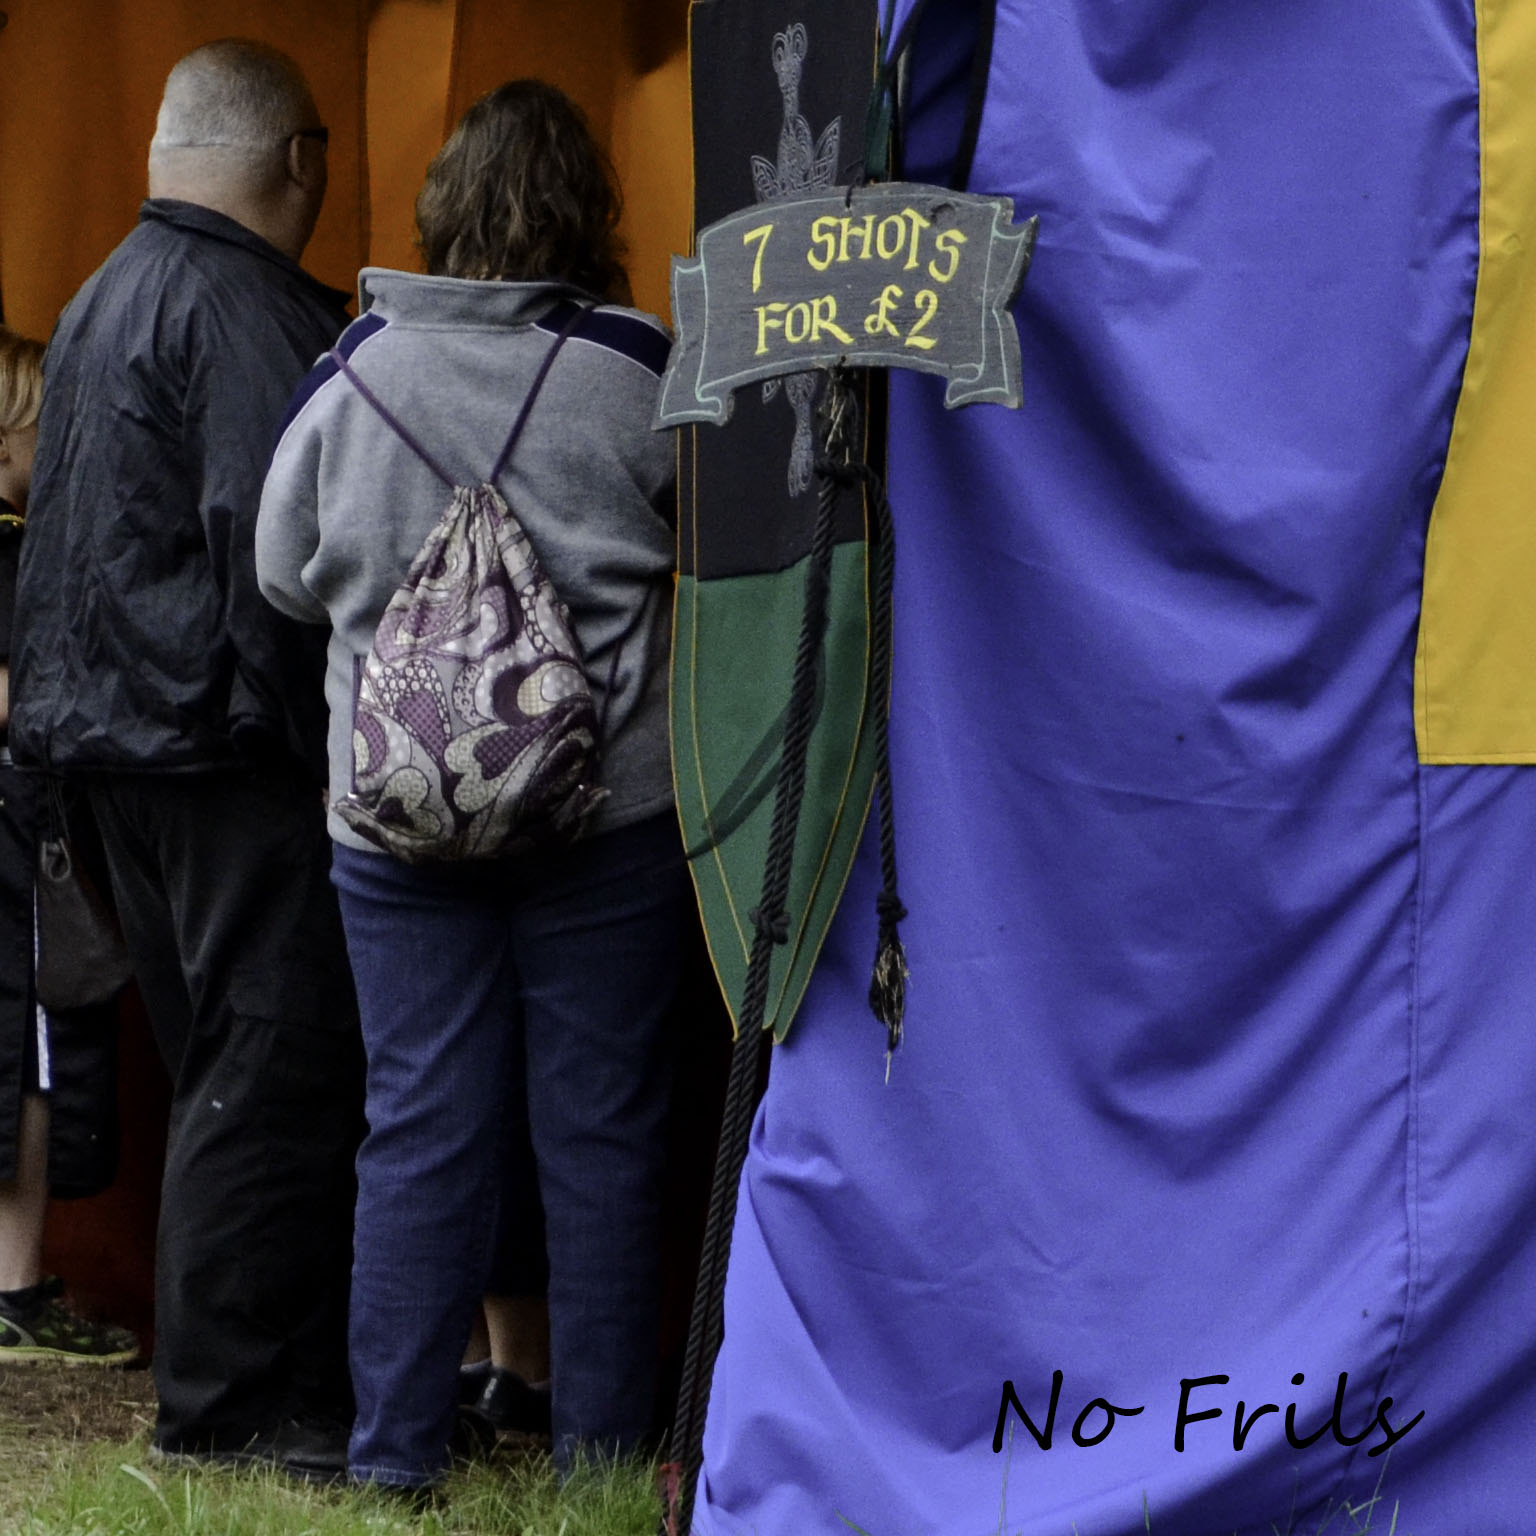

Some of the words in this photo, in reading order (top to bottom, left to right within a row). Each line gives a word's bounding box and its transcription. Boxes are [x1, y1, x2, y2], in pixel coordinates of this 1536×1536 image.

[743, 224, 774, 294] 7
[807, 207, 968, 284] SHOTS
[753, 294, 855, 355] FOR
[863, 284, 938, 350] £2
